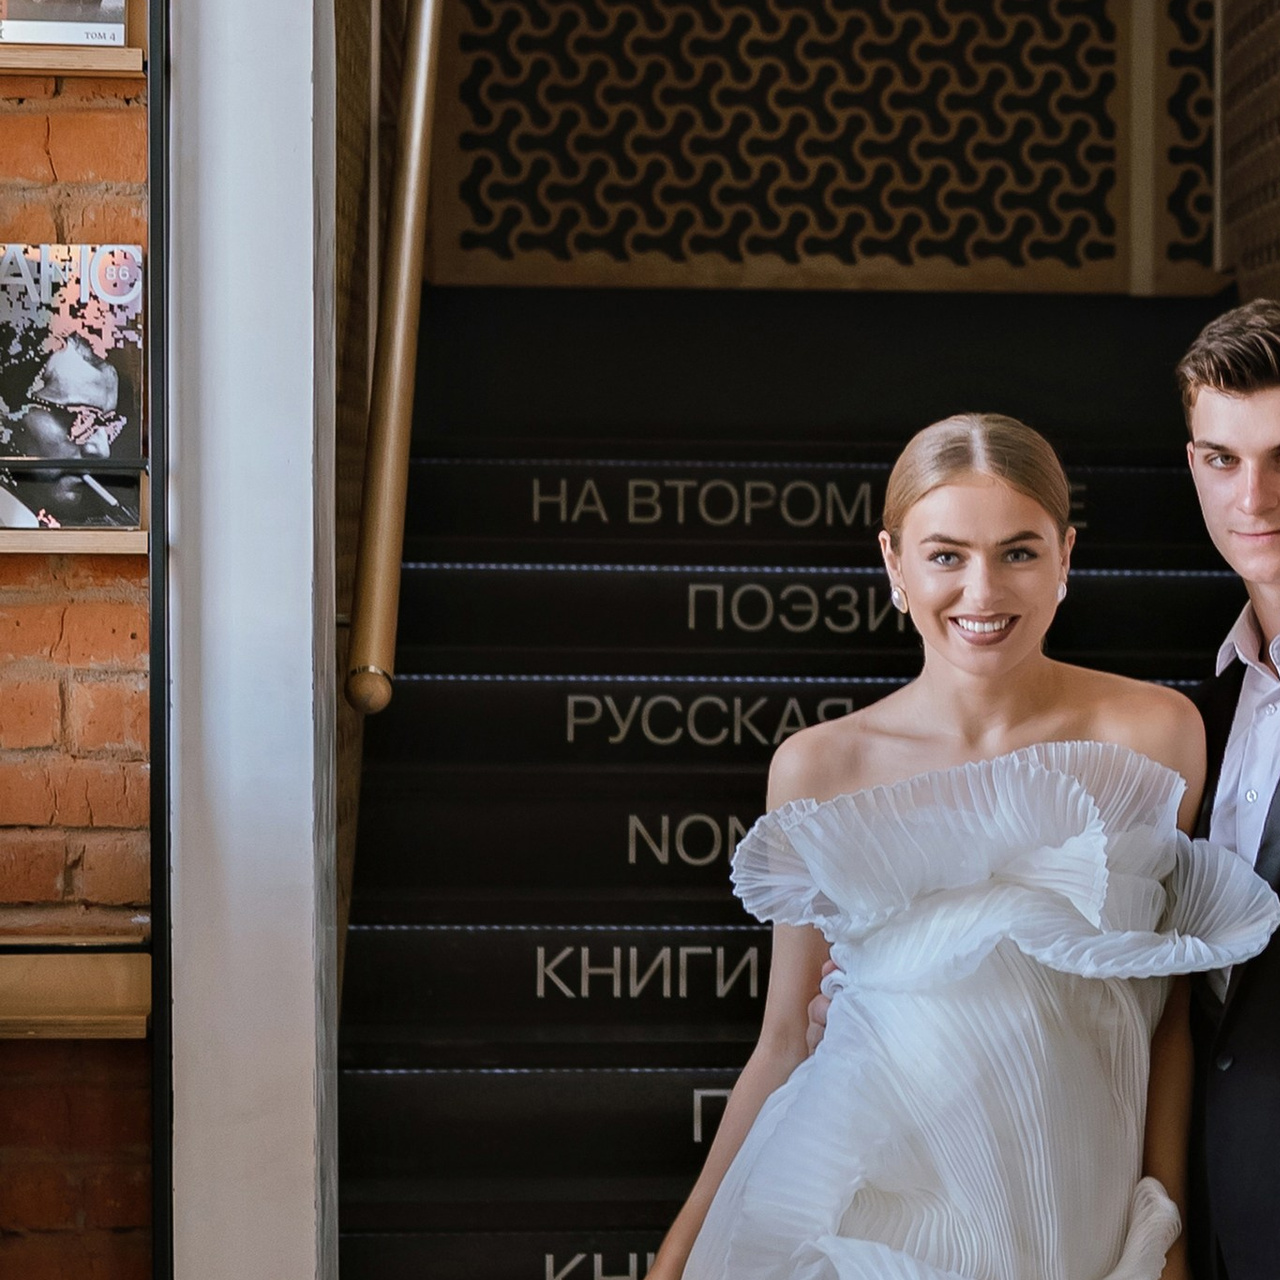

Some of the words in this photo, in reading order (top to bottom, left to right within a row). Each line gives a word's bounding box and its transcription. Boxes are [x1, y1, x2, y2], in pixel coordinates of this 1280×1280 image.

[105, 266, 130, 280] 86
[531, 476, 610, 524] НА
[627, 477, 872, 529] ВТОРОМ
[687, 583, 919, 634] ПОЭЗИ
[534, 945, 759, 1000] КНИГИ
